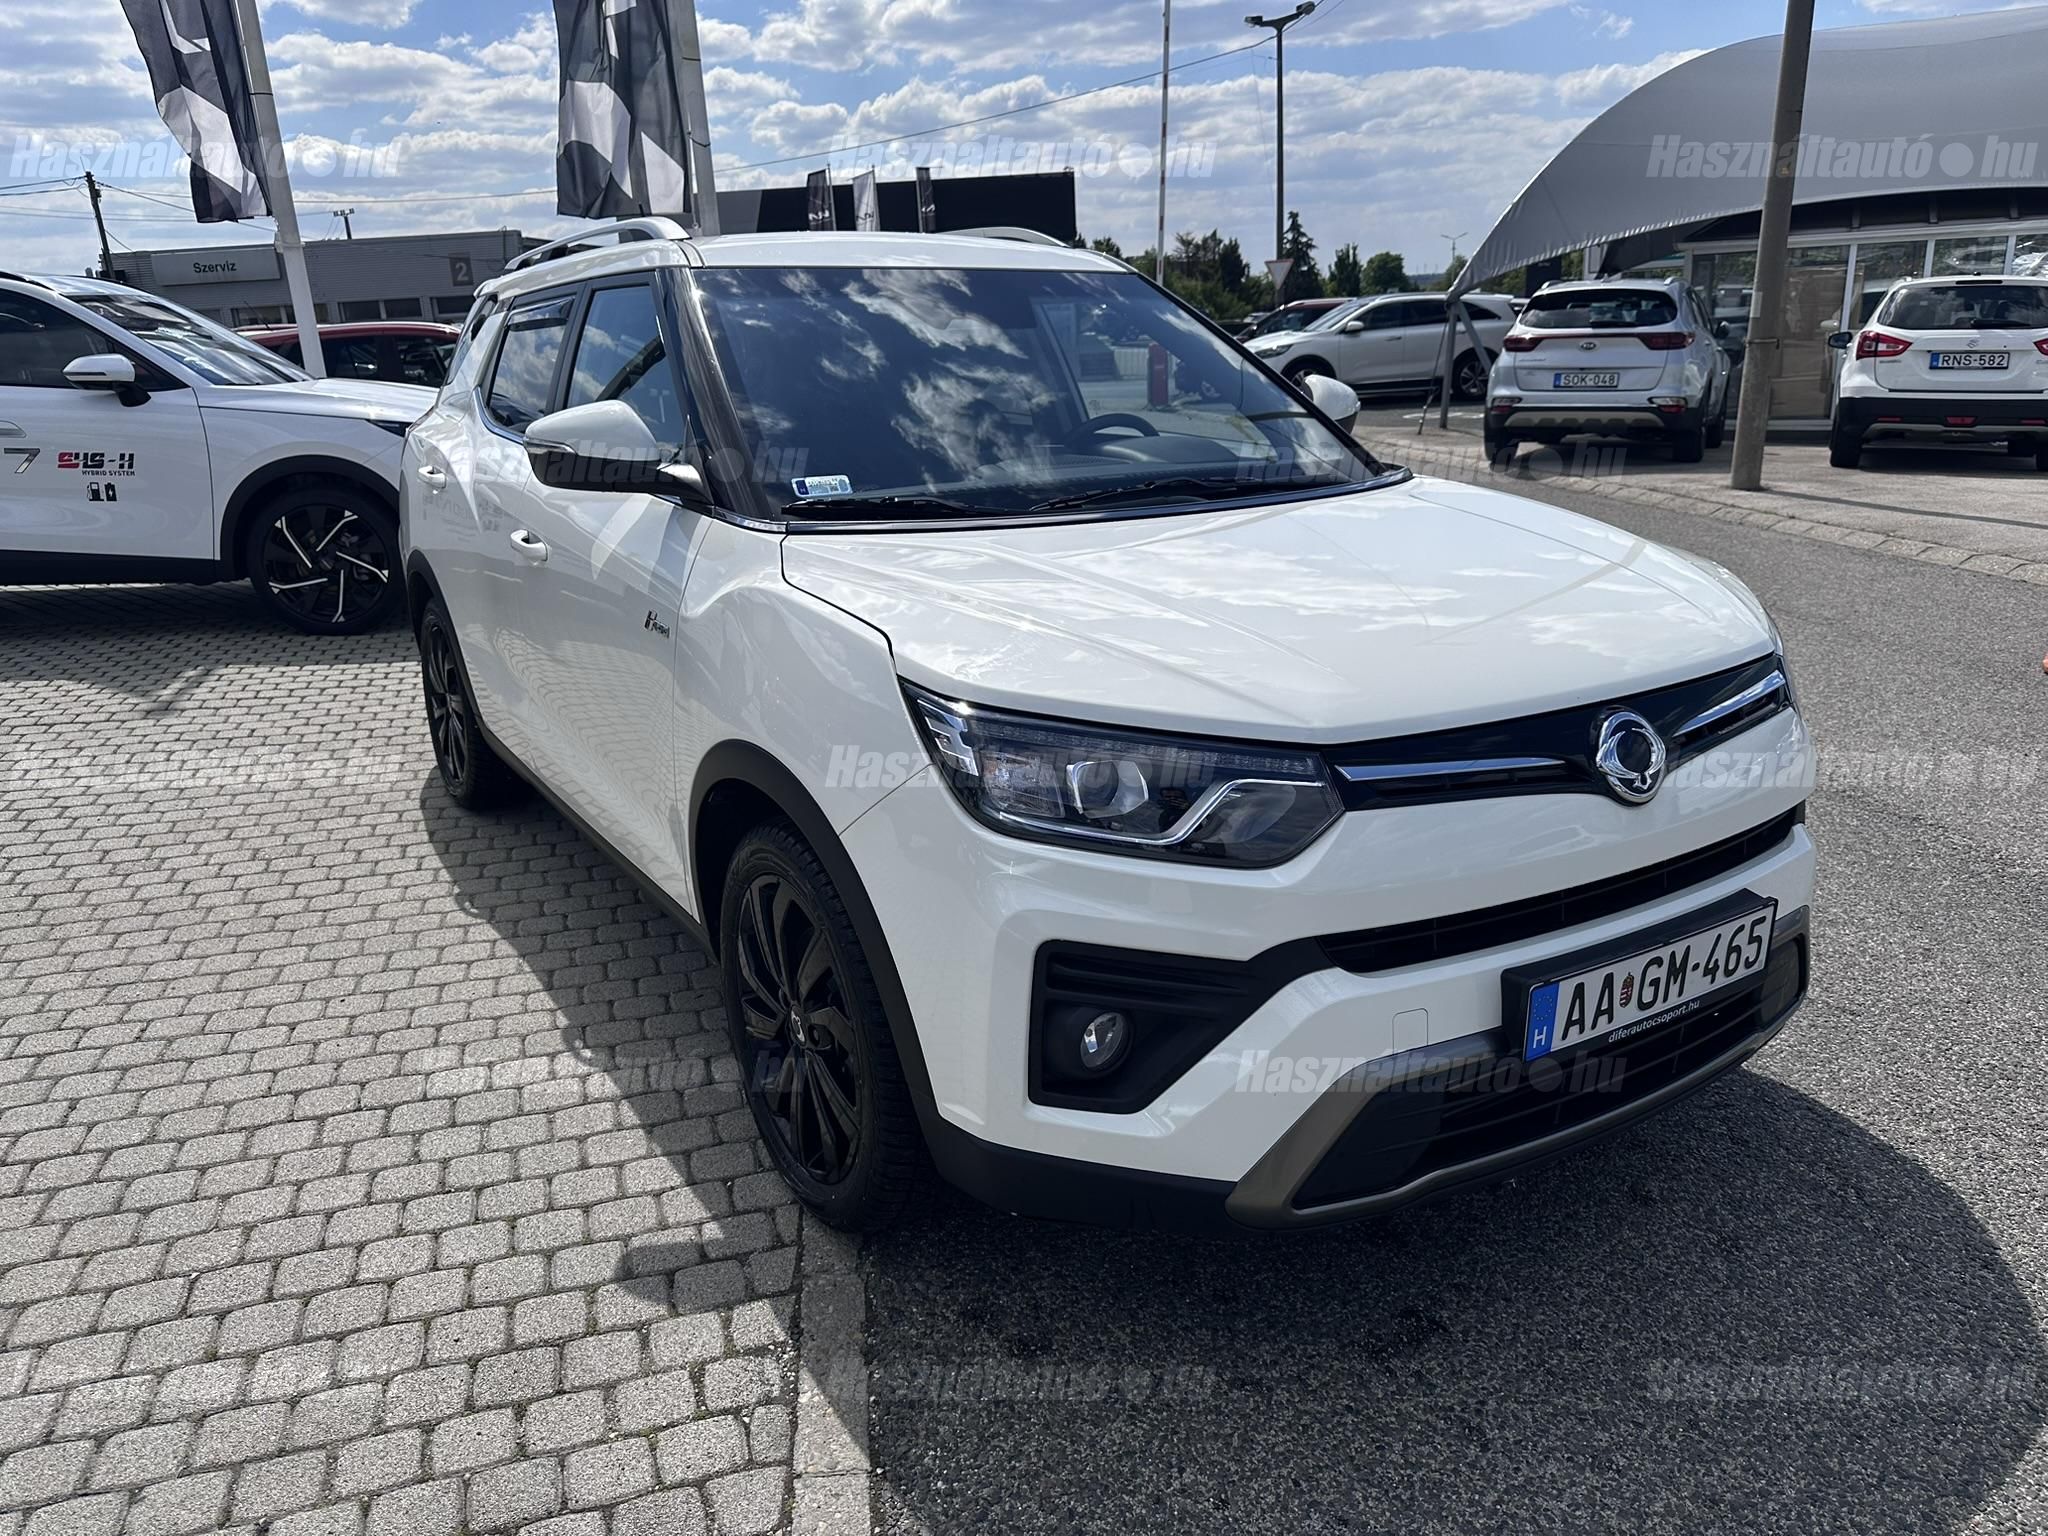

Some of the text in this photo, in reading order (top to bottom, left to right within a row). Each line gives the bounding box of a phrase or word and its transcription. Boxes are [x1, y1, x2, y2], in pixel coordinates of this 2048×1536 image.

[193, 260, 237, 274] Szerviz
[455, 262, 469, 282] 2
[1941, 354, 2006, 366] RNS-582
[1563, 374, 1616, 385] SOK-048
[3, 447, 41, 474] 7
[1560, 971, 1615, 1041] AA
[1607, 999, 1701, 1044] diferautocsoport.hu
[1532, 1026, 1547, 1049] H
